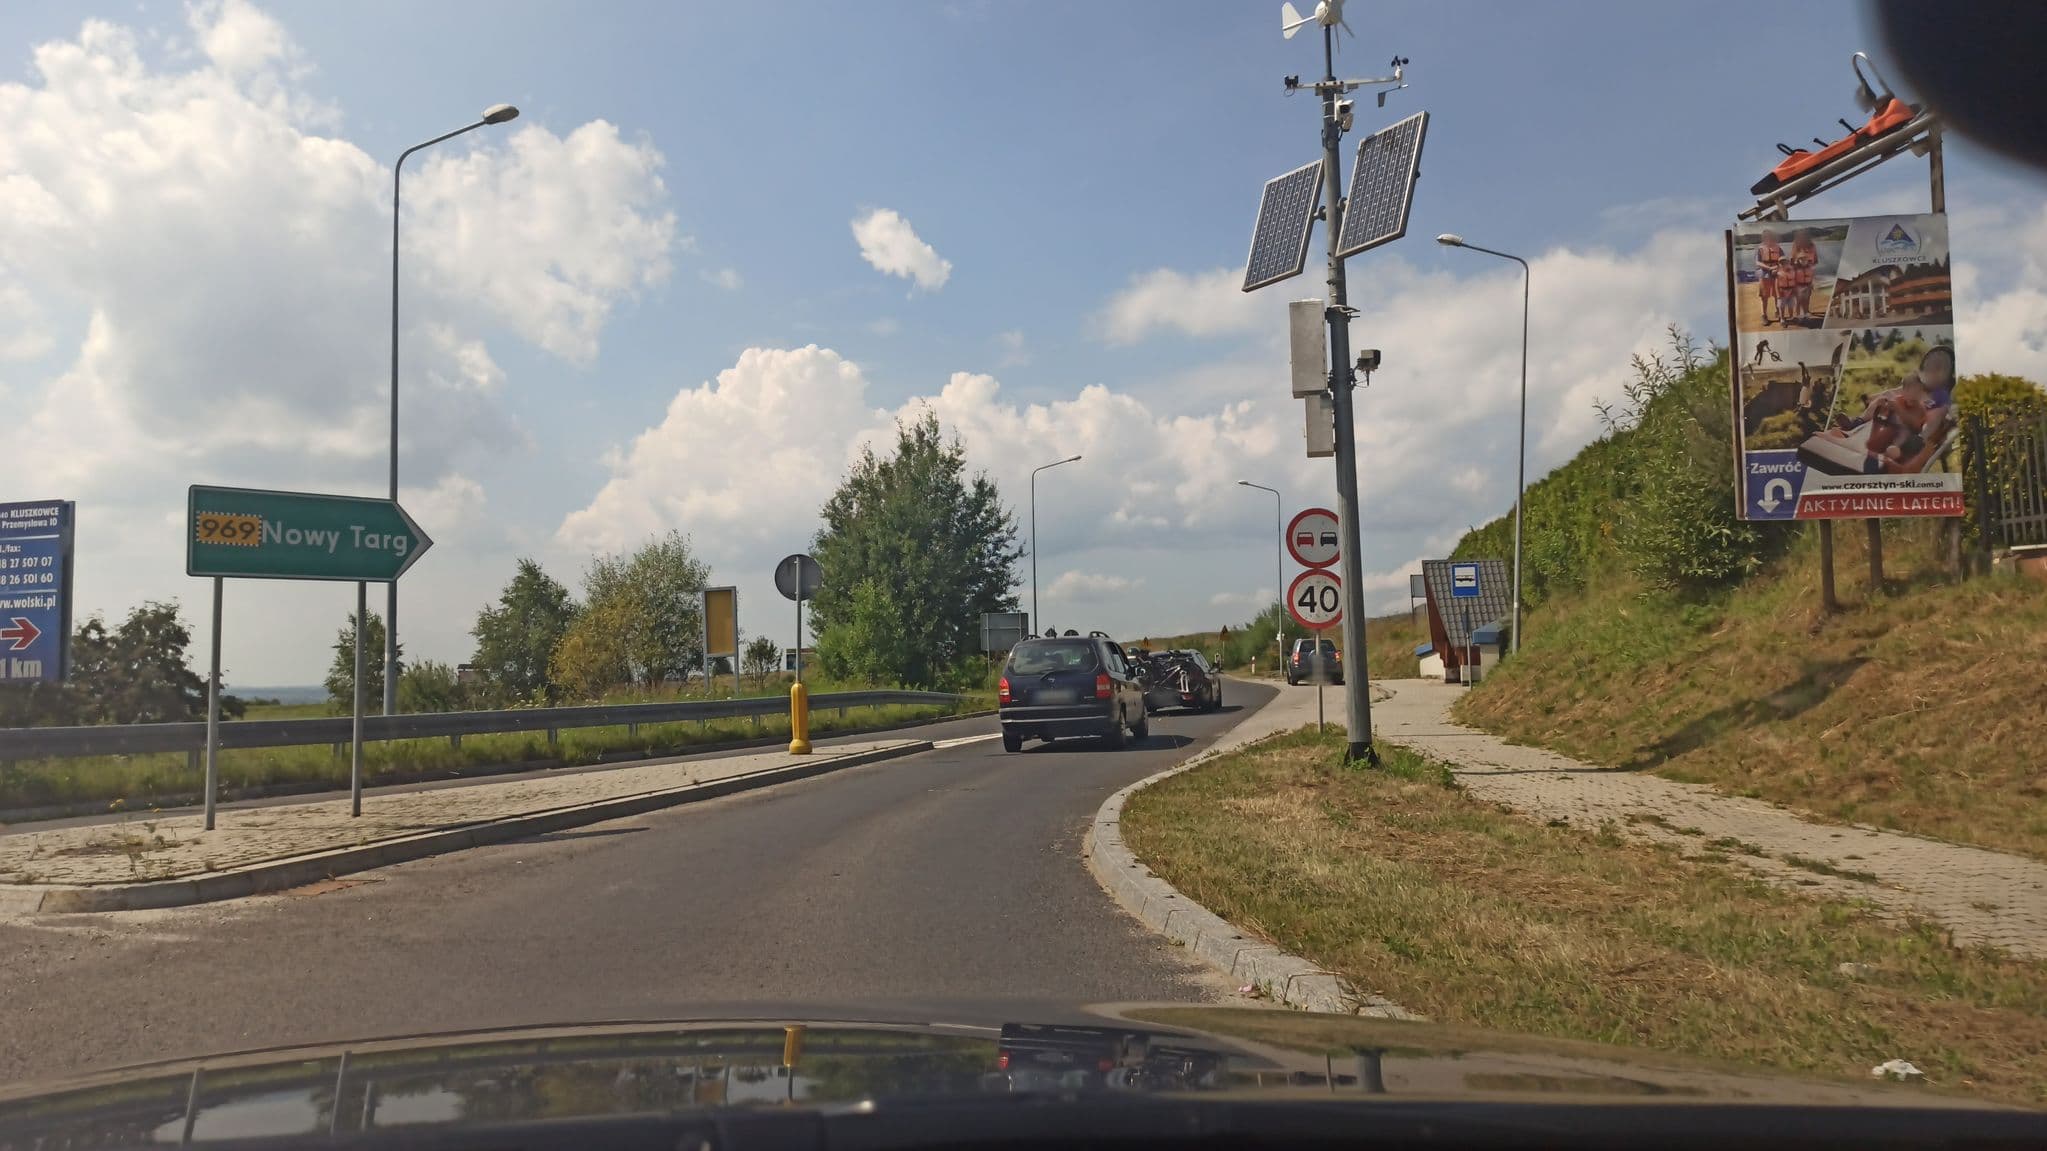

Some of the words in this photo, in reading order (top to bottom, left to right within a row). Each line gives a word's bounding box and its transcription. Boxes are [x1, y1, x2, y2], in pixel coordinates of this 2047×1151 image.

[1751, 462, 1802, 475] Zawróć
[1821, 480, 1944, 491] www.czorsztyn-ski.com.pl
[1803, 498, 1895, 513] AKTYWNIE
[1902, 496, 1961, 511] LATEM!
[10, 507, 60, 518] KLUSZKOWCE
[202, 518, 256, 539] 969
[261, 520, 341, 554] Nowy
[350, 525, 408, 557] Targ
[10, 558, 20, 568] 27
[22, 557, 39, 568] 507
[41, 556, 53, 567] 07
[10, 574, 21, 585] 26
[23, 573, 38, 584] 501
[40, 572, 54, 583] 60
[1298, 585, 1339, 613] 40
[11, 657, 42, 679] km
